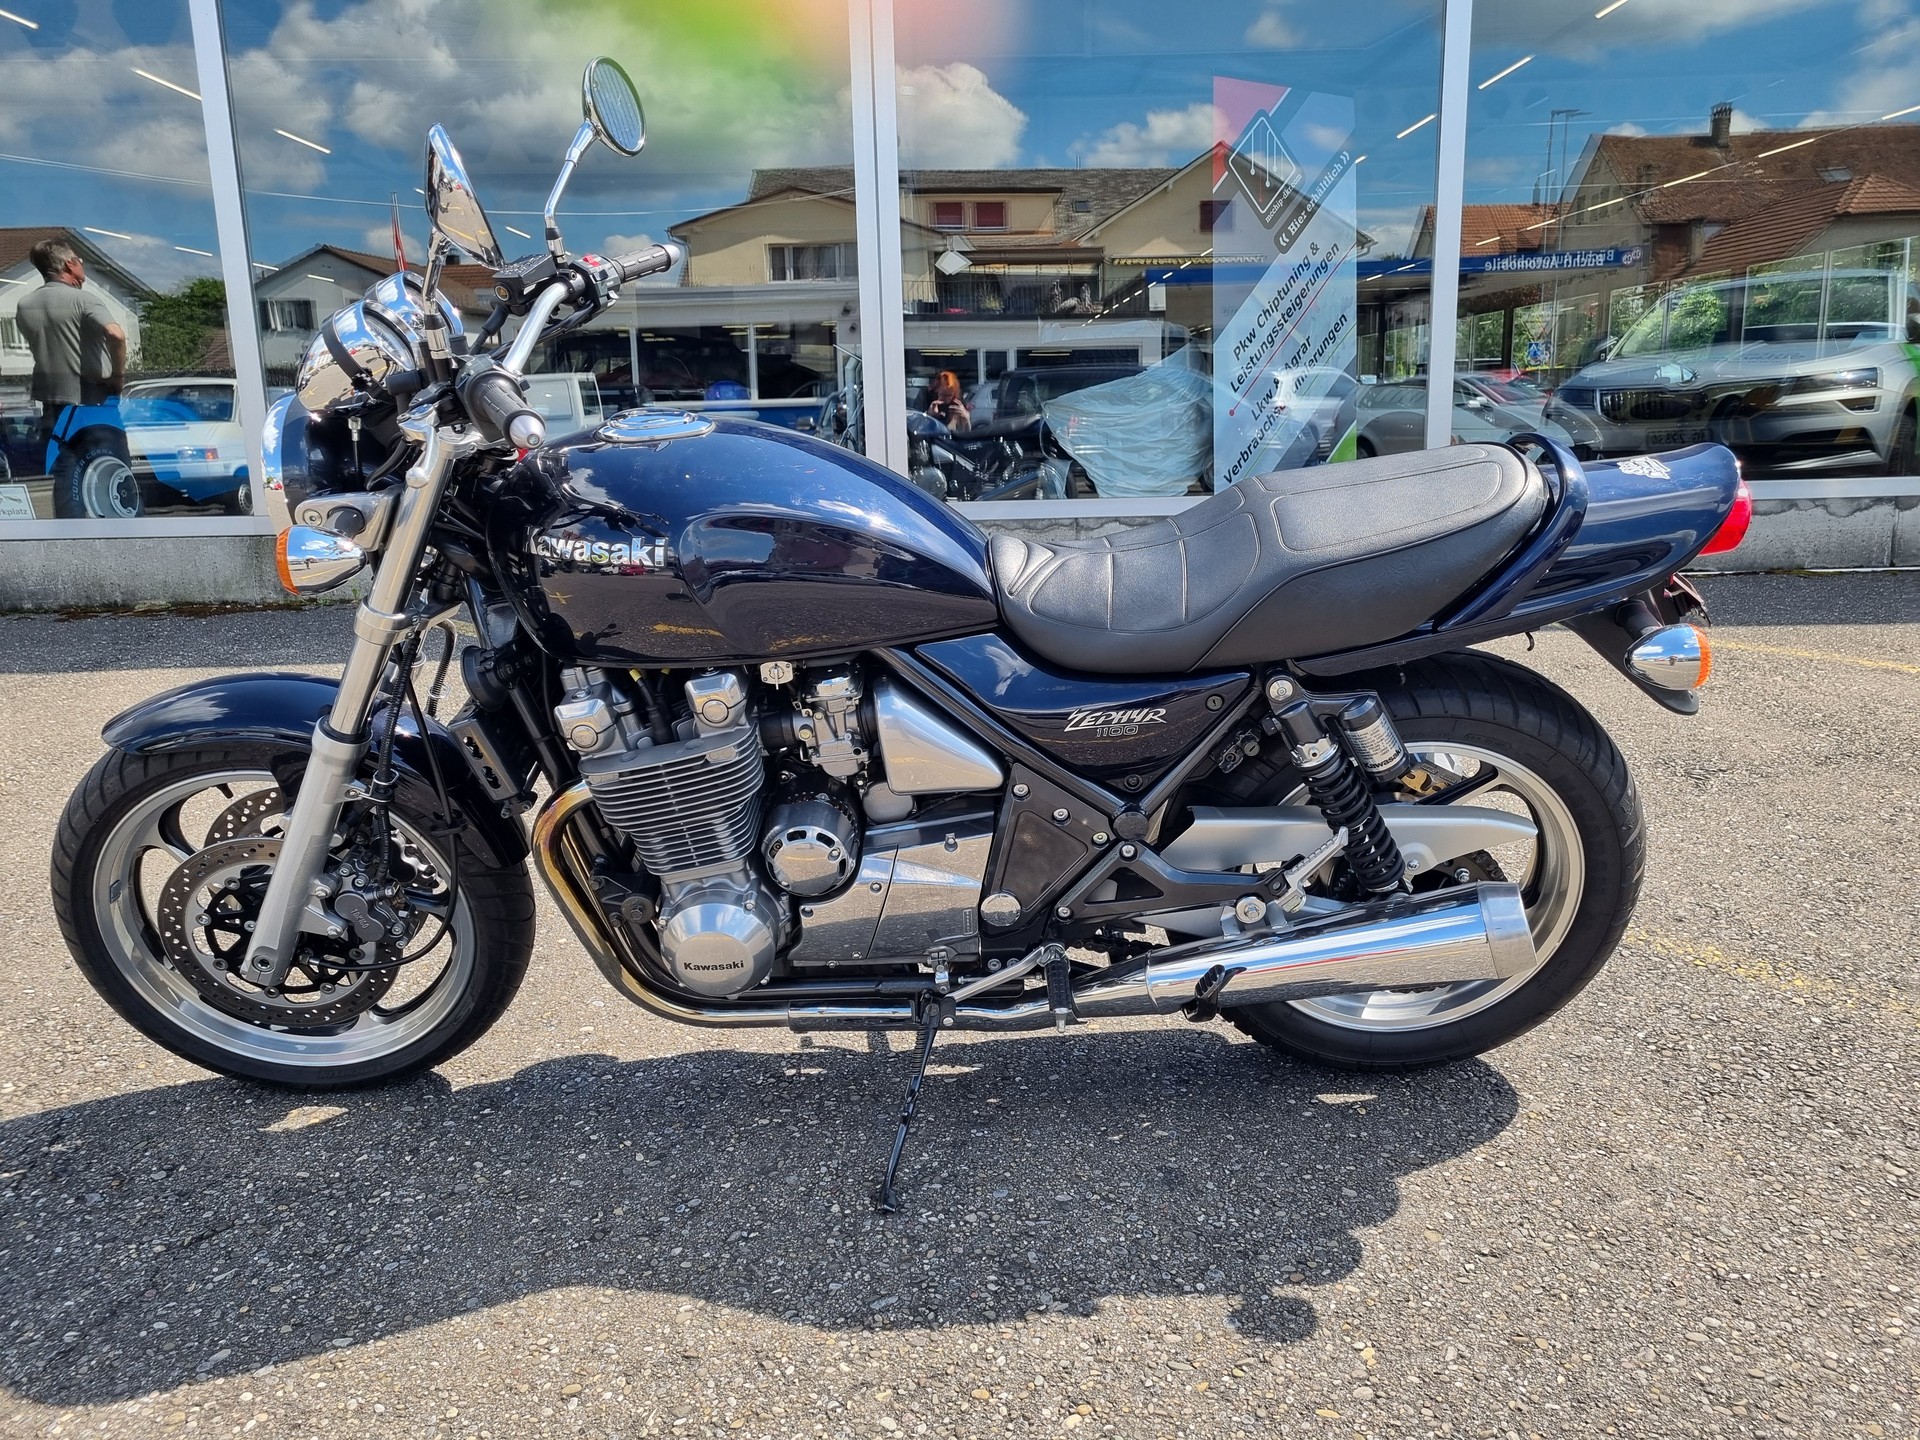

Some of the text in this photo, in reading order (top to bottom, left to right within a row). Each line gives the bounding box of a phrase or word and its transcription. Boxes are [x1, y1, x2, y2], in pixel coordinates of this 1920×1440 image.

[1265, 173, 1302, 223] mcchip-dkr.com
[1287, 210, 1308, 236] Hier
[1306, 162, 1343, 212] erhältlich
[1230, 243, 1340, 393] Leistungssteigerungen
[1233, 241, 1320, 361] Pkw Chiptuning &
[1223, 313, 1348, 484] Verbrauchsomierungen
[1250, 387, 1274, 421] Lkw
[72, 459, 86, 501] COOPER
[523, 526, 667, 567] Kawasaki
[1064, 708, 1167, 732] ZEPHYR
[1096, 725, 1138, 738] 1100
[1363, 746, 1402, 769] Kawasaki
[683, 960, 744, 971] Kawasaki
